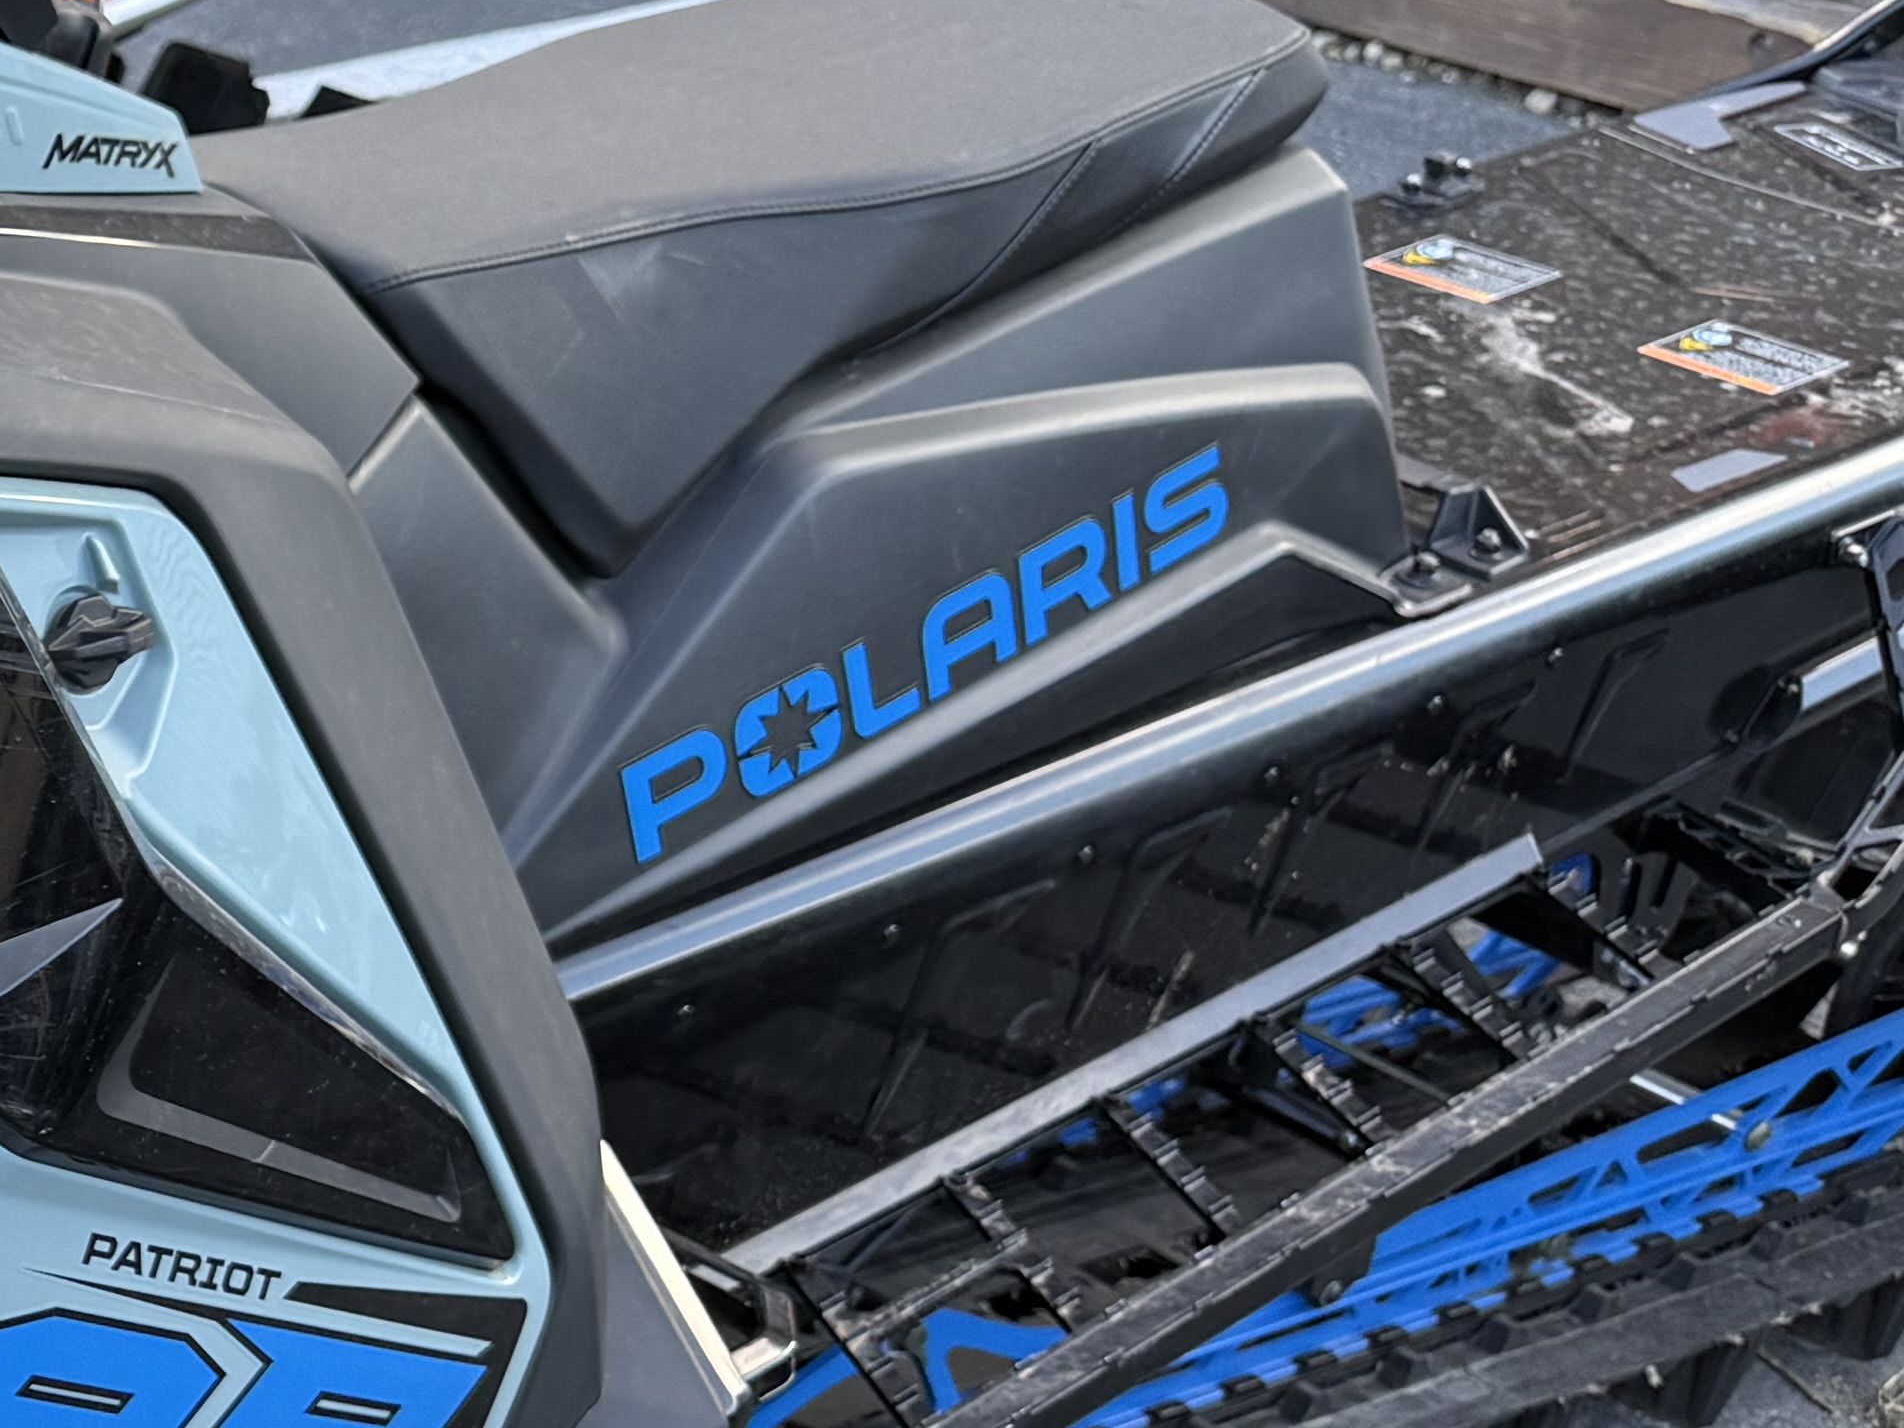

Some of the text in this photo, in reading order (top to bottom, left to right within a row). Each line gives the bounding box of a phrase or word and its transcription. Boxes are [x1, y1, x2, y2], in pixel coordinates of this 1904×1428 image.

[41, 132, 179, 179] MATRYX
[620, 441, 1229, 863] POLARIS
[81, 1233, 284, 1301] PATRIOT
